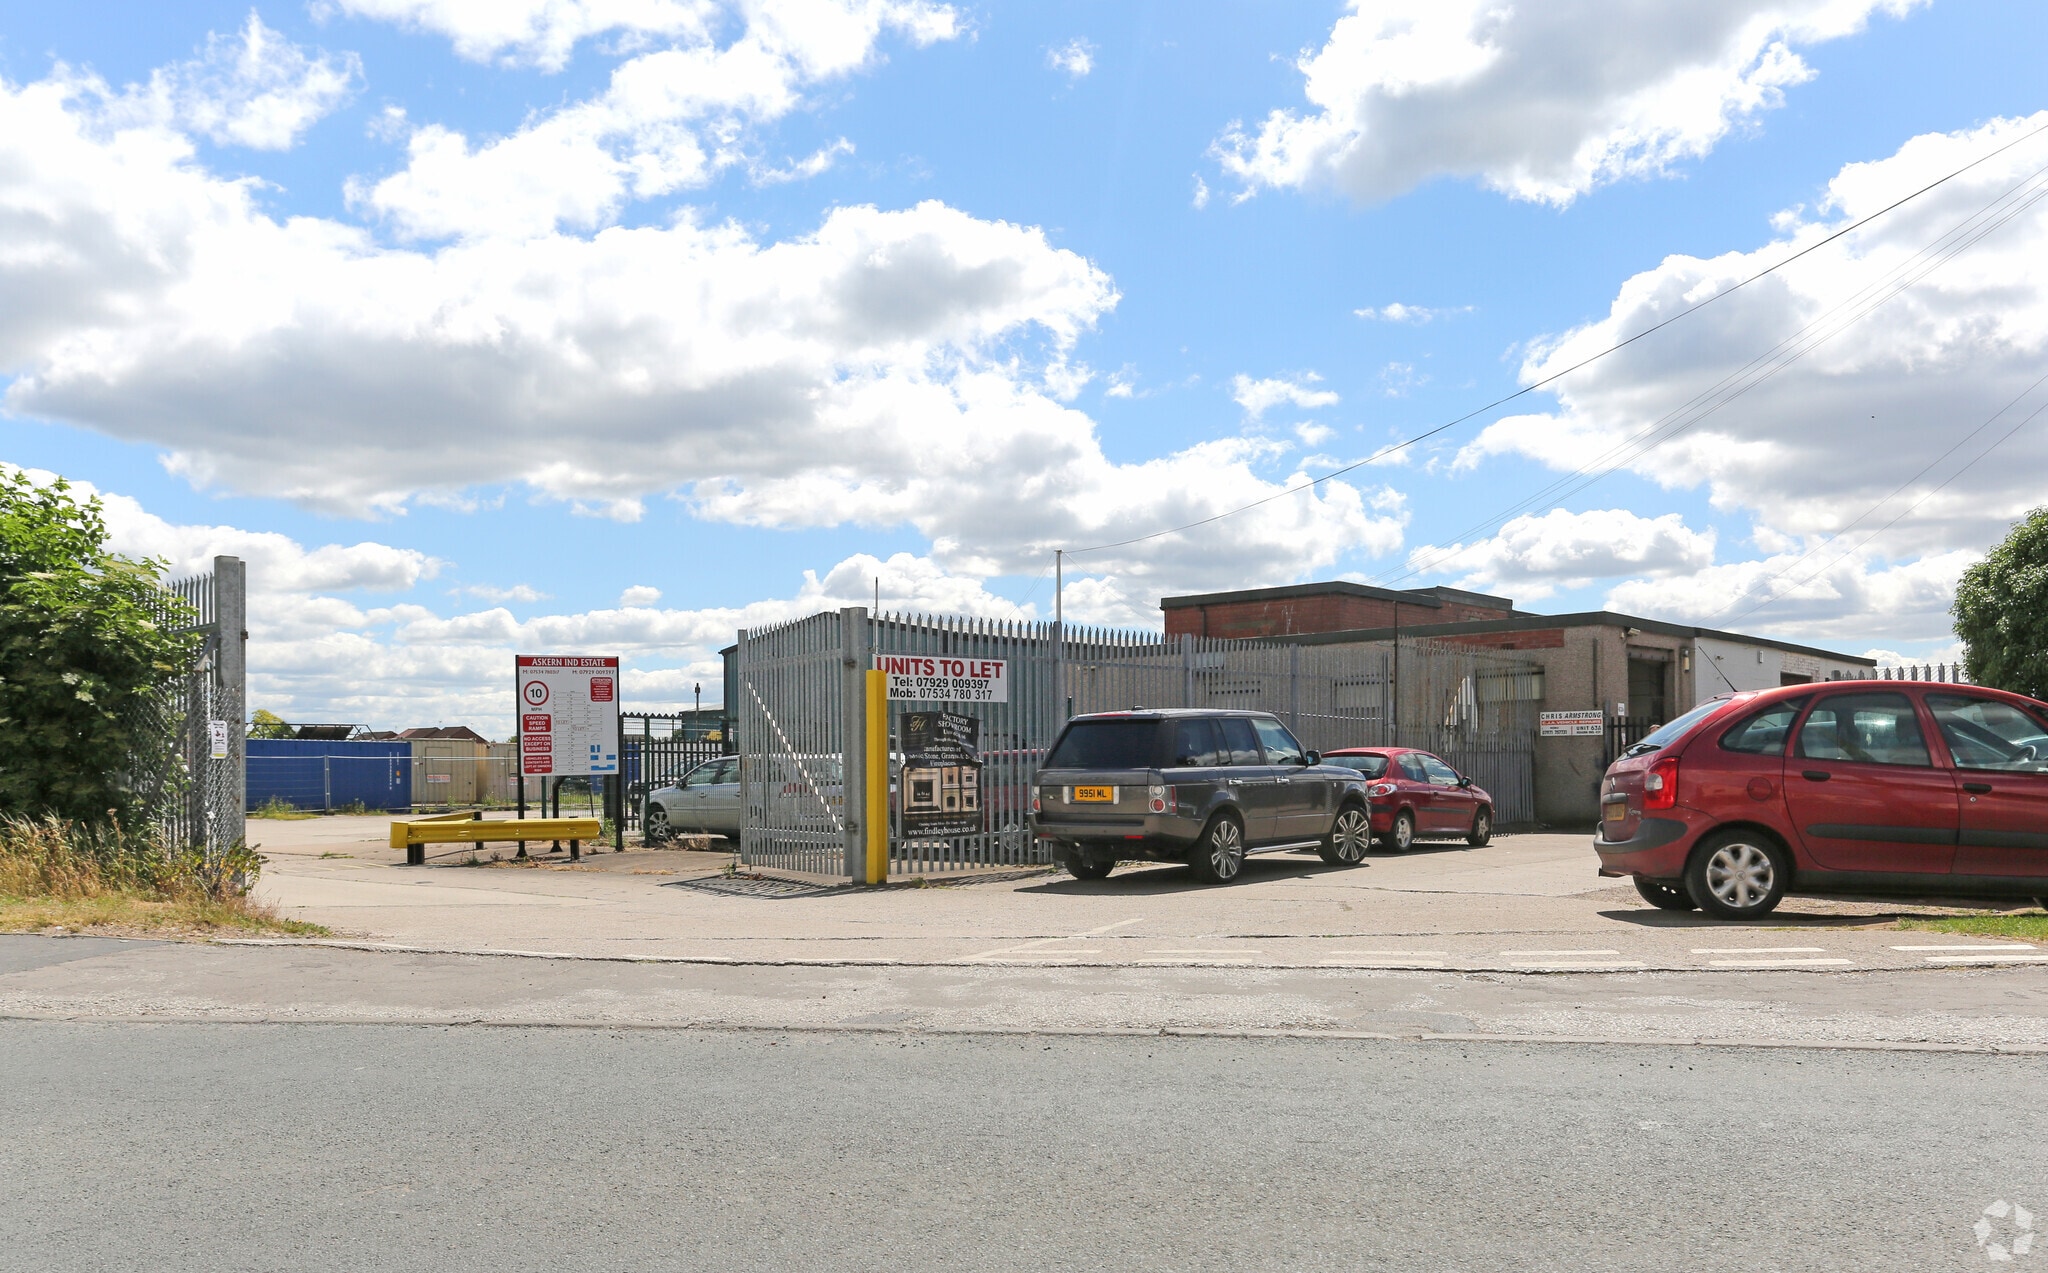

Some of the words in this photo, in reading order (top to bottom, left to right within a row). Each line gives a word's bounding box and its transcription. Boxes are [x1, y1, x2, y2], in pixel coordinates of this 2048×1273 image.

[531, 658, 562, 667] ASKERN
[564, 658, 579, 667] IND
[580, 658, 606, 667] ESTATE
[876, 656, 935, 677] UNITS
[939, 659, 965, 678] TO
[969, 660, 1004, 679] LET
[893, 676, 913, 687] Tel:
[916, 677, 949, 688] 07929
[951, 678, 990, 690] 009397
[530, 688, 542, 698] 10
[889, 687, 916, 698] Mob:
[919, 688, 951, 699] 07534
[953, 689, 972, 700] 780
[974, 689, 993, 700] 317
[942, 713, 969, 726] FACTORY
[1079, 789, 1095, 798] 9951
[1097, 789, 1107, 798] ML
[907, 824, 976, 836] www.findleyhouse.co.uk
